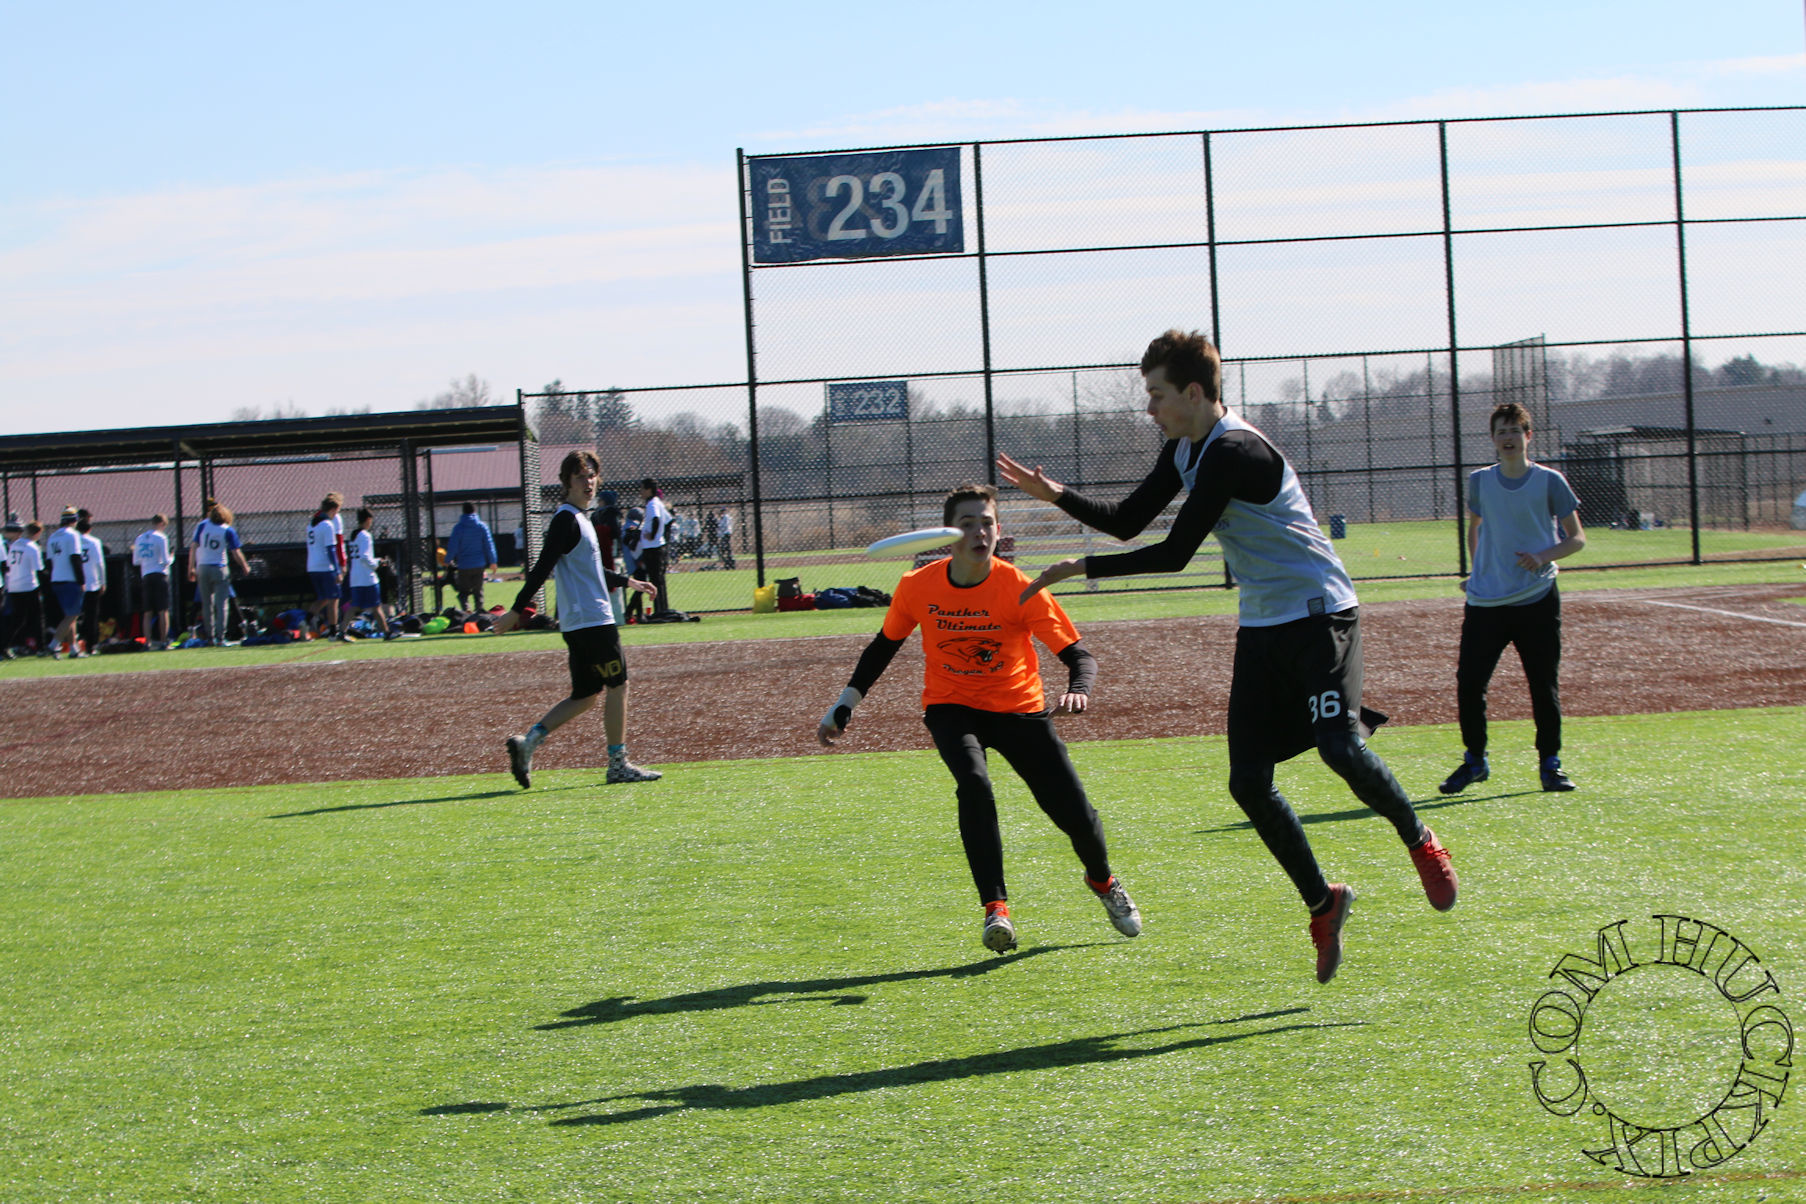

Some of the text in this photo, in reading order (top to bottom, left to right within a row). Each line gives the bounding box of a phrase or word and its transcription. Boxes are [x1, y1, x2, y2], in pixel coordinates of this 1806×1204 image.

[767, 179, 792, 243] FIELD
[825, 168, 953, 241] 234
[853, 388, 901, 416] 232
[927, 604, 990, 618] Panther
[936, 619, 1002, 632] Ultimate
